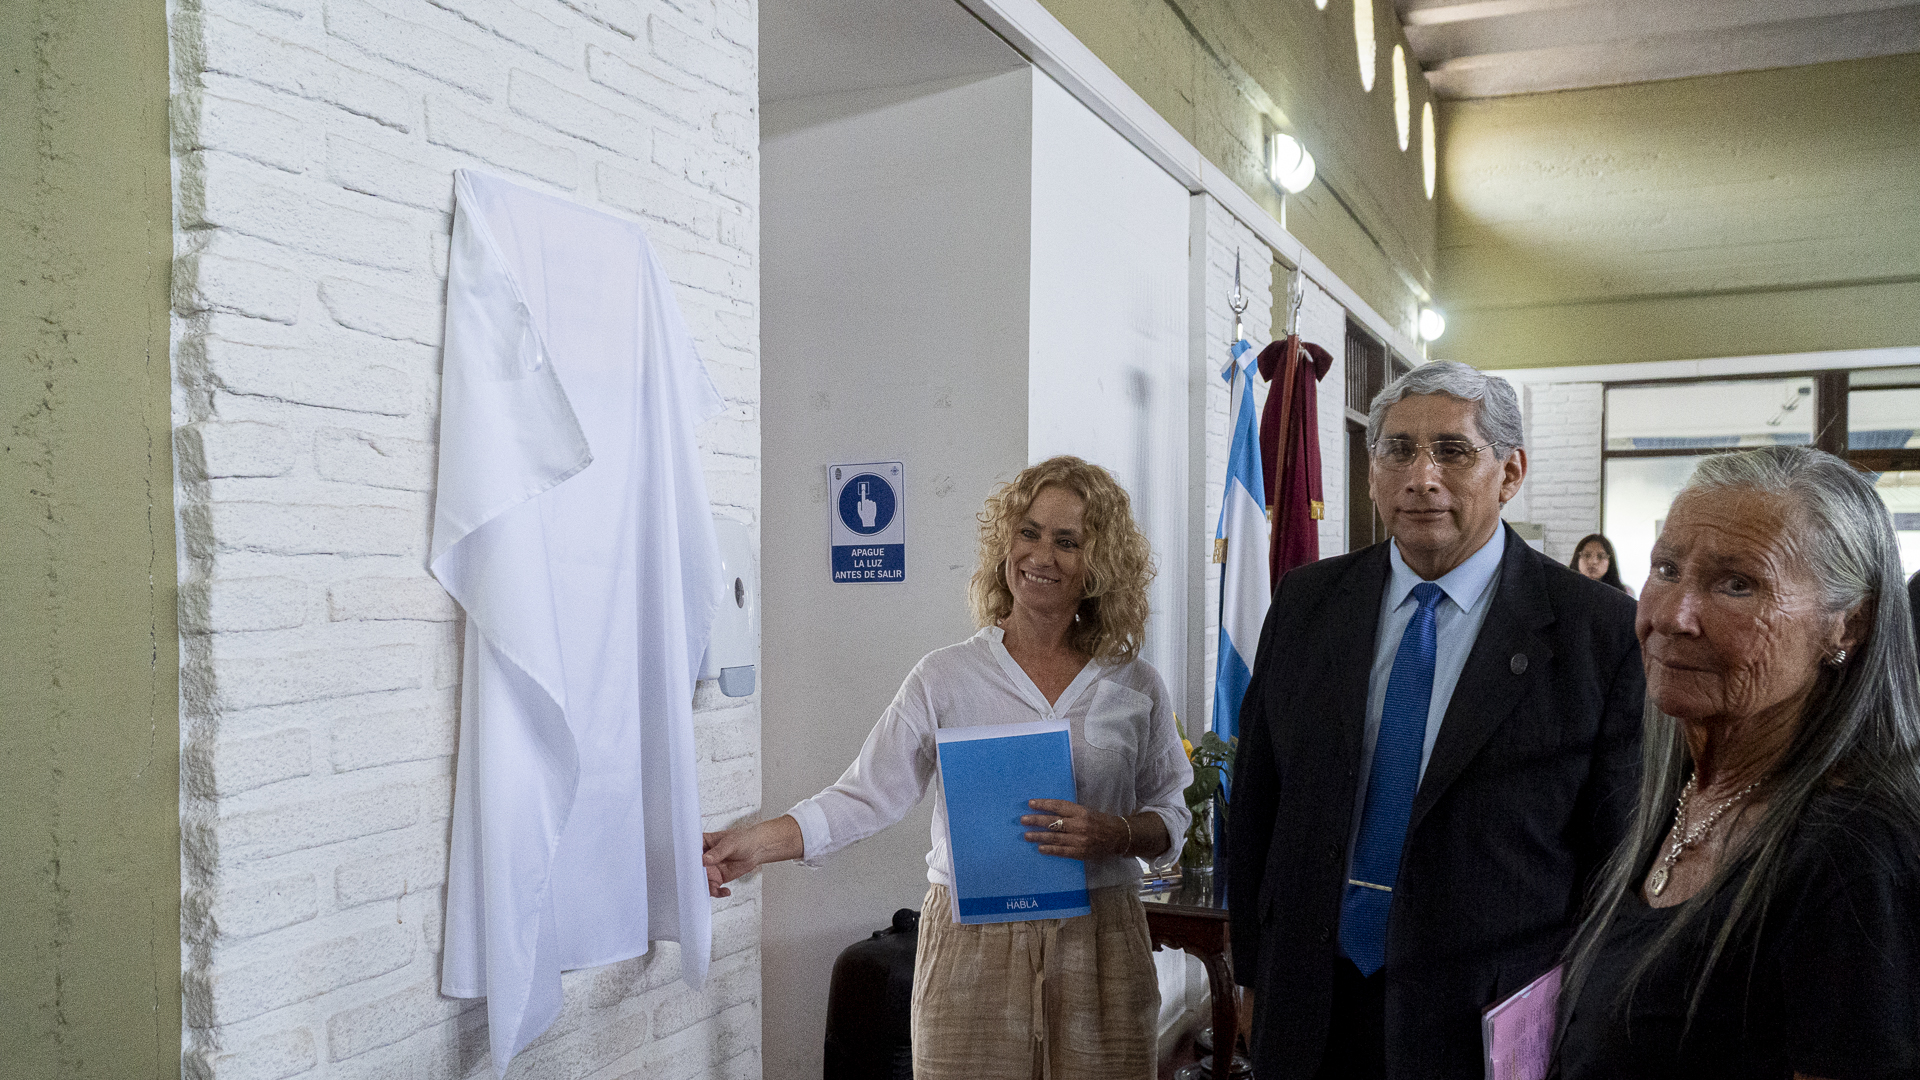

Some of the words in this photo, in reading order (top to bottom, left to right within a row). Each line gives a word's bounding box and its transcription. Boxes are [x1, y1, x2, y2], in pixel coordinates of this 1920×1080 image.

[851, 548, 884, 556] APAGUE
[866, 559, 882, 567] LUZ
[835, 571, 861, 579] ANTES
[864, 570, 875, 578] DE
[877, 570, 902, 578] SALIR
[1006, 900, 1039, 909] HABLA
